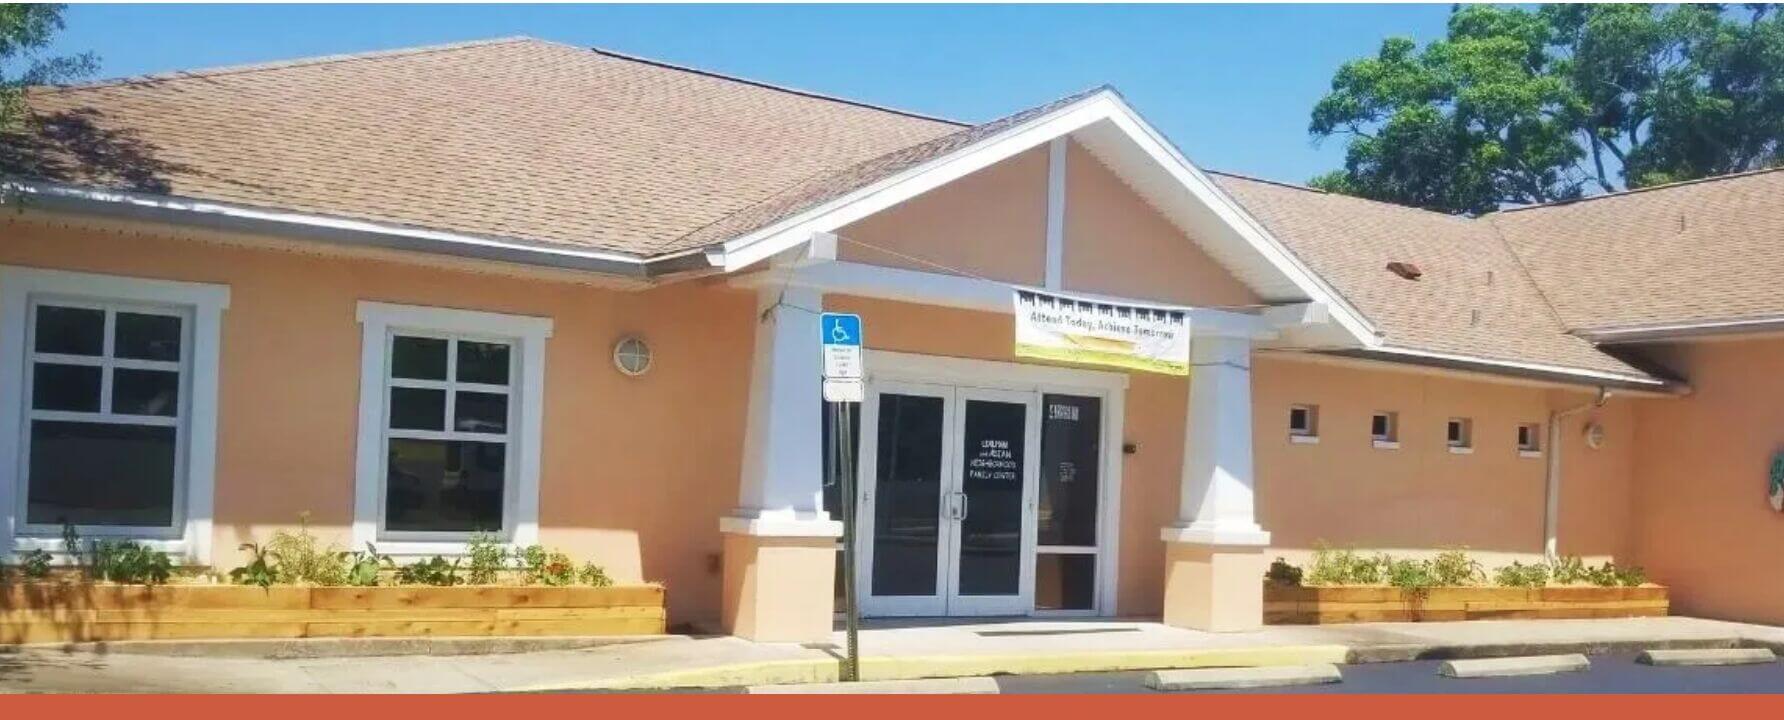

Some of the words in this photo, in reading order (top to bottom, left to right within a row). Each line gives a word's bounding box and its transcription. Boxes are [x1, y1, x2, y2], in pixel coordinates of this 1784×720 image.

[1030, 311, 1062, 325] Attend
[1098, 320, 1130, 334] Achieve
[1133, 324, 1174, 340] Tomorrow
